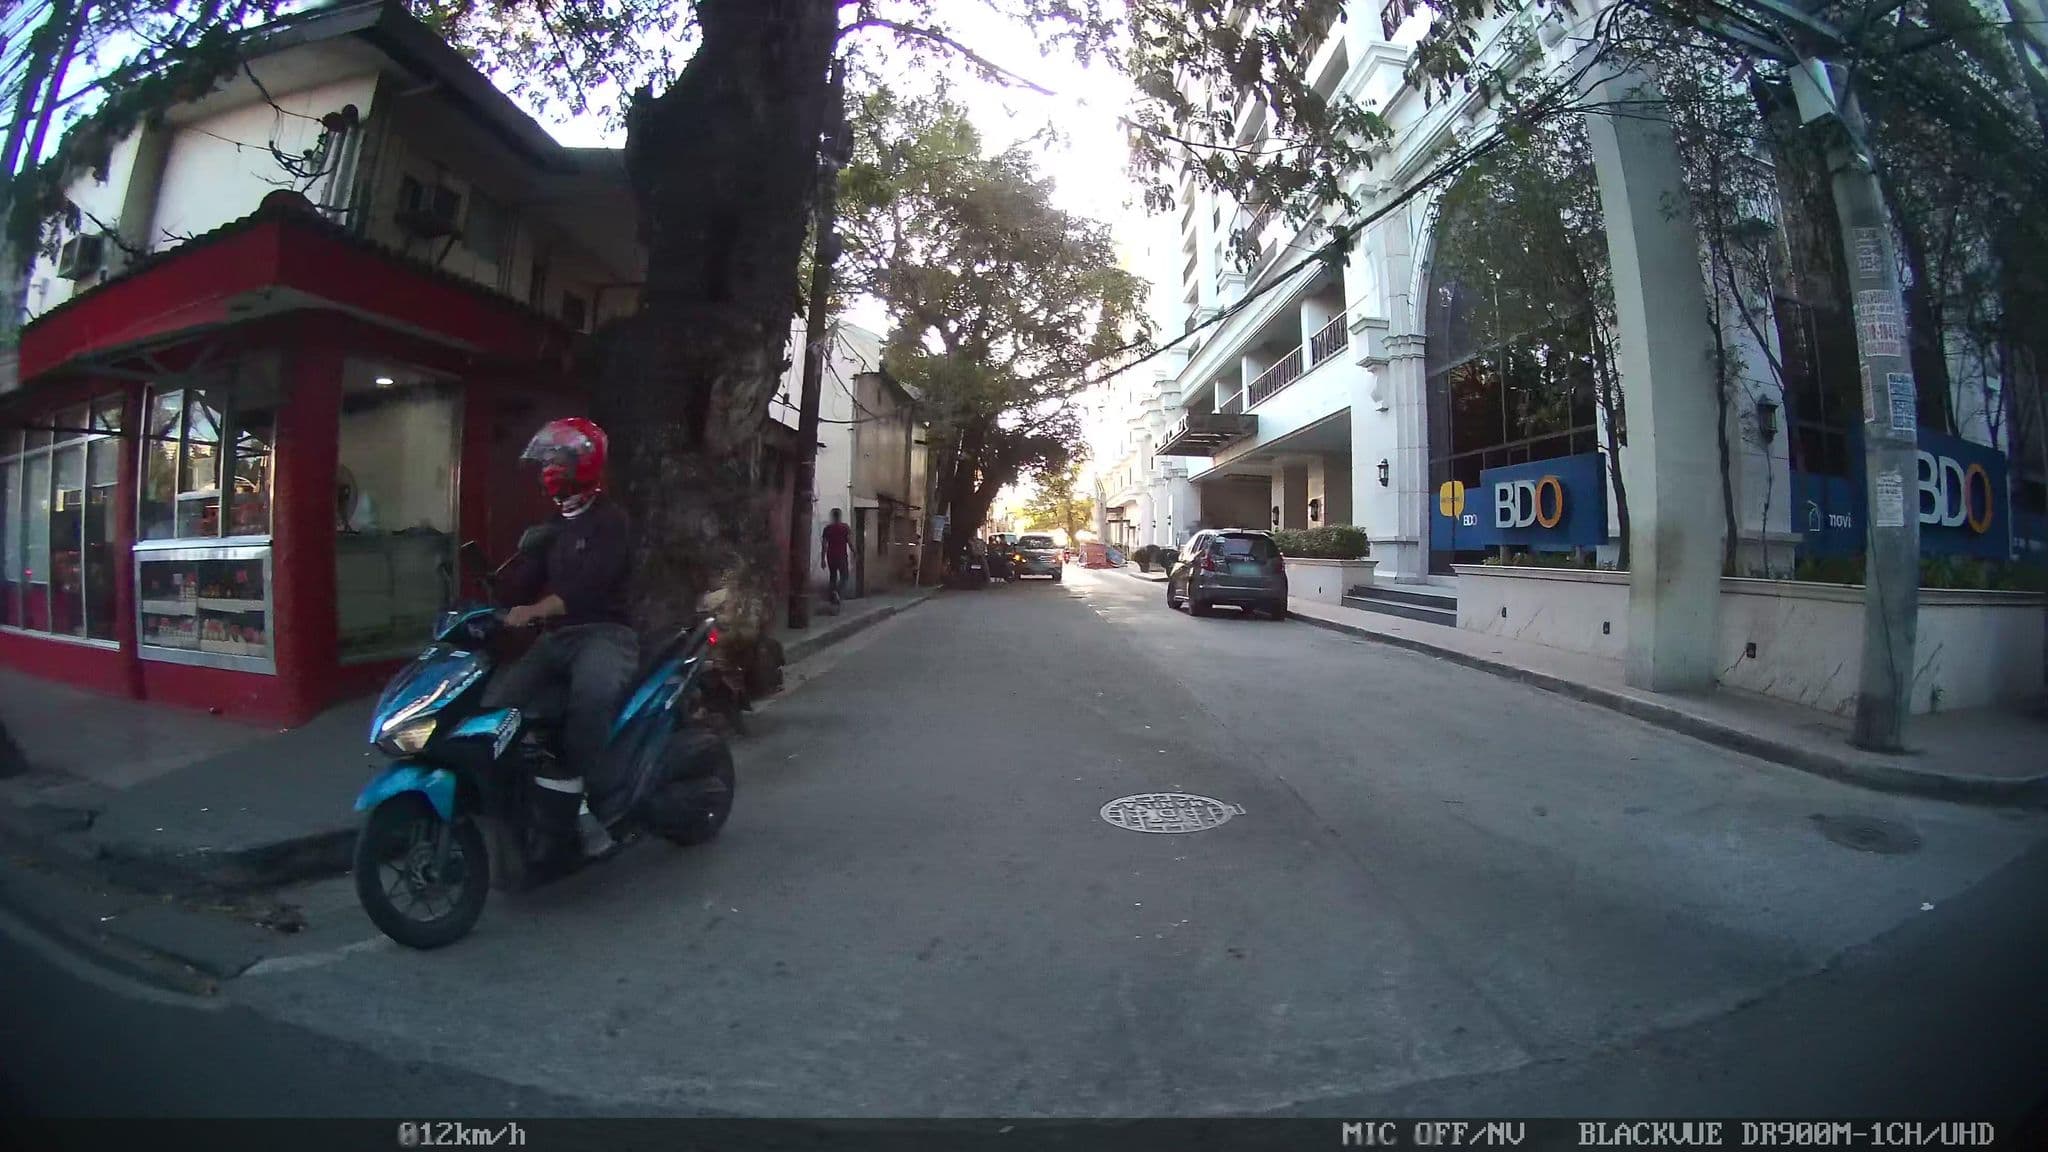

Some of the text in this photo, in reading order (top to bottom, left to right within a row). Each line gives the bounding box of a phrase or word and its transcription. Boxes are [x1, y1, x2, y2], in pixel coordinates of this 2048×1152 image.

[1495, 476, 1563, 528] BDO
[1918, 450, 1994, 534] BDO
[1463, 514, 1478, 526] BDO
